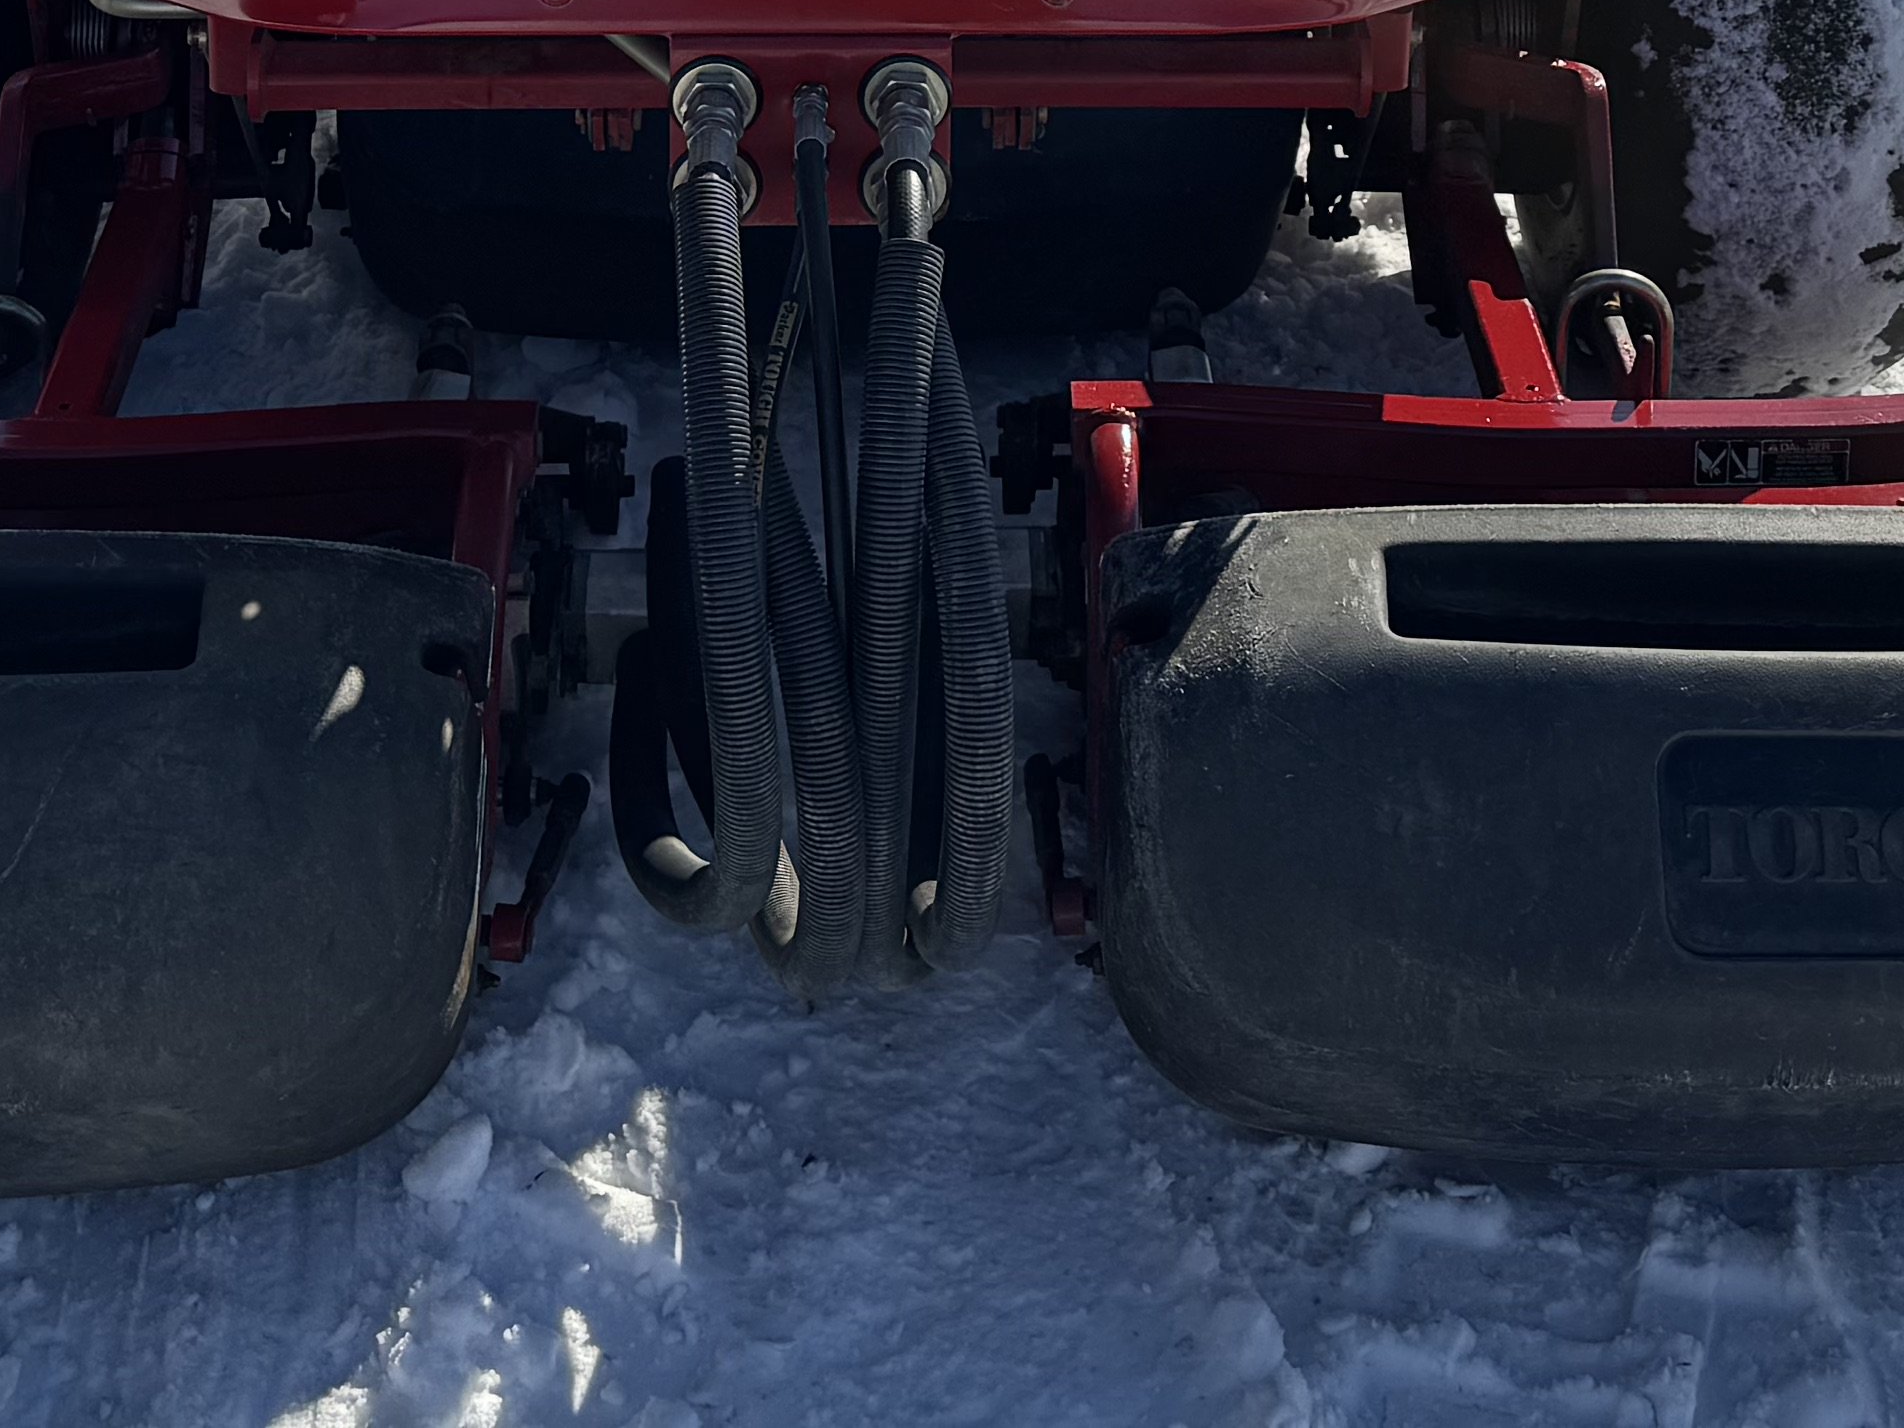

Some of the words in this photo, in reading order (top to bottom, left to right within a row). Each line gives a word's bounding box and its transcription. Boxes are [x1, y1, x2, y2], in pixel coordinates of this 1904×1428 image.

[775, 302, 798, 343] Parker
[754, 349, 785, 428] TOUGH
[1780, 442, 1831, 452] DAGER
